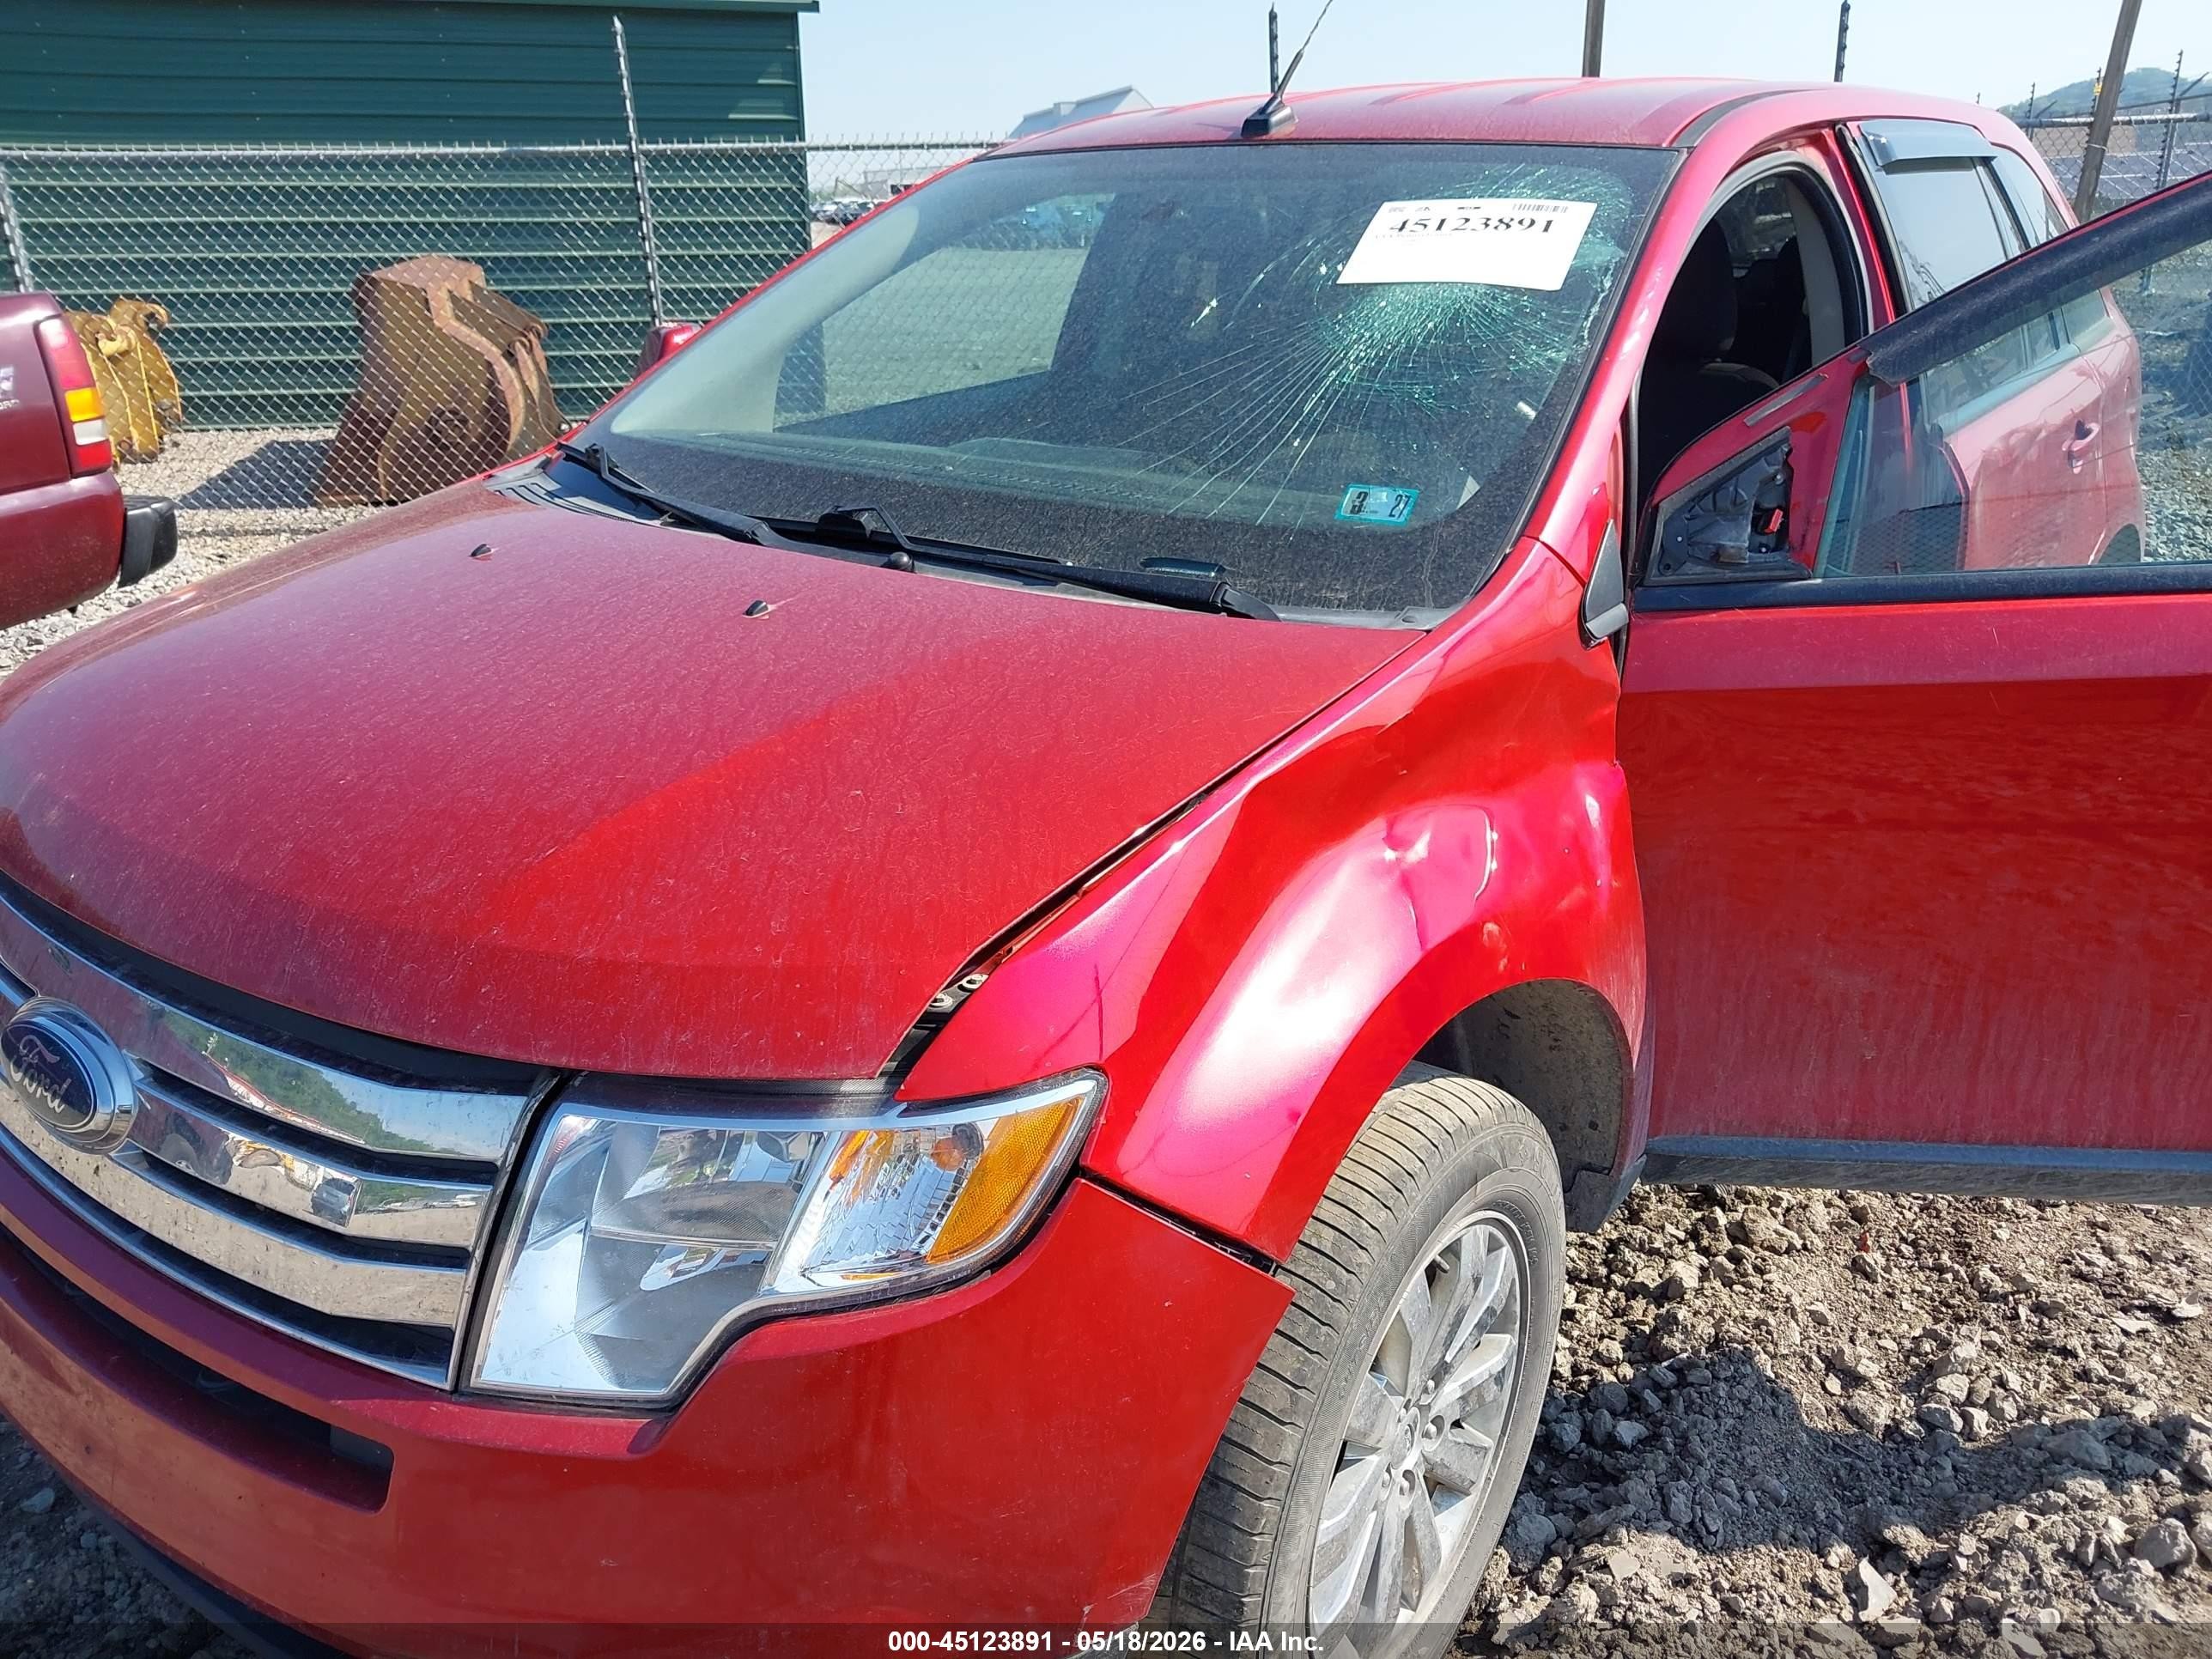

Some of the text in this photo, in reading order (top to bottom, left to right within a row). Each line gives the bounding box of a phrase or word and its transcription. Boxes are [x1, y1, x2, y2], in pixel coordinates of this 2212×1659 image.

[1389, 216, 1554, 233] 45123891
[1389, 494, 1412, 519] 27
[10, 1035, 72, 1114] Ford
